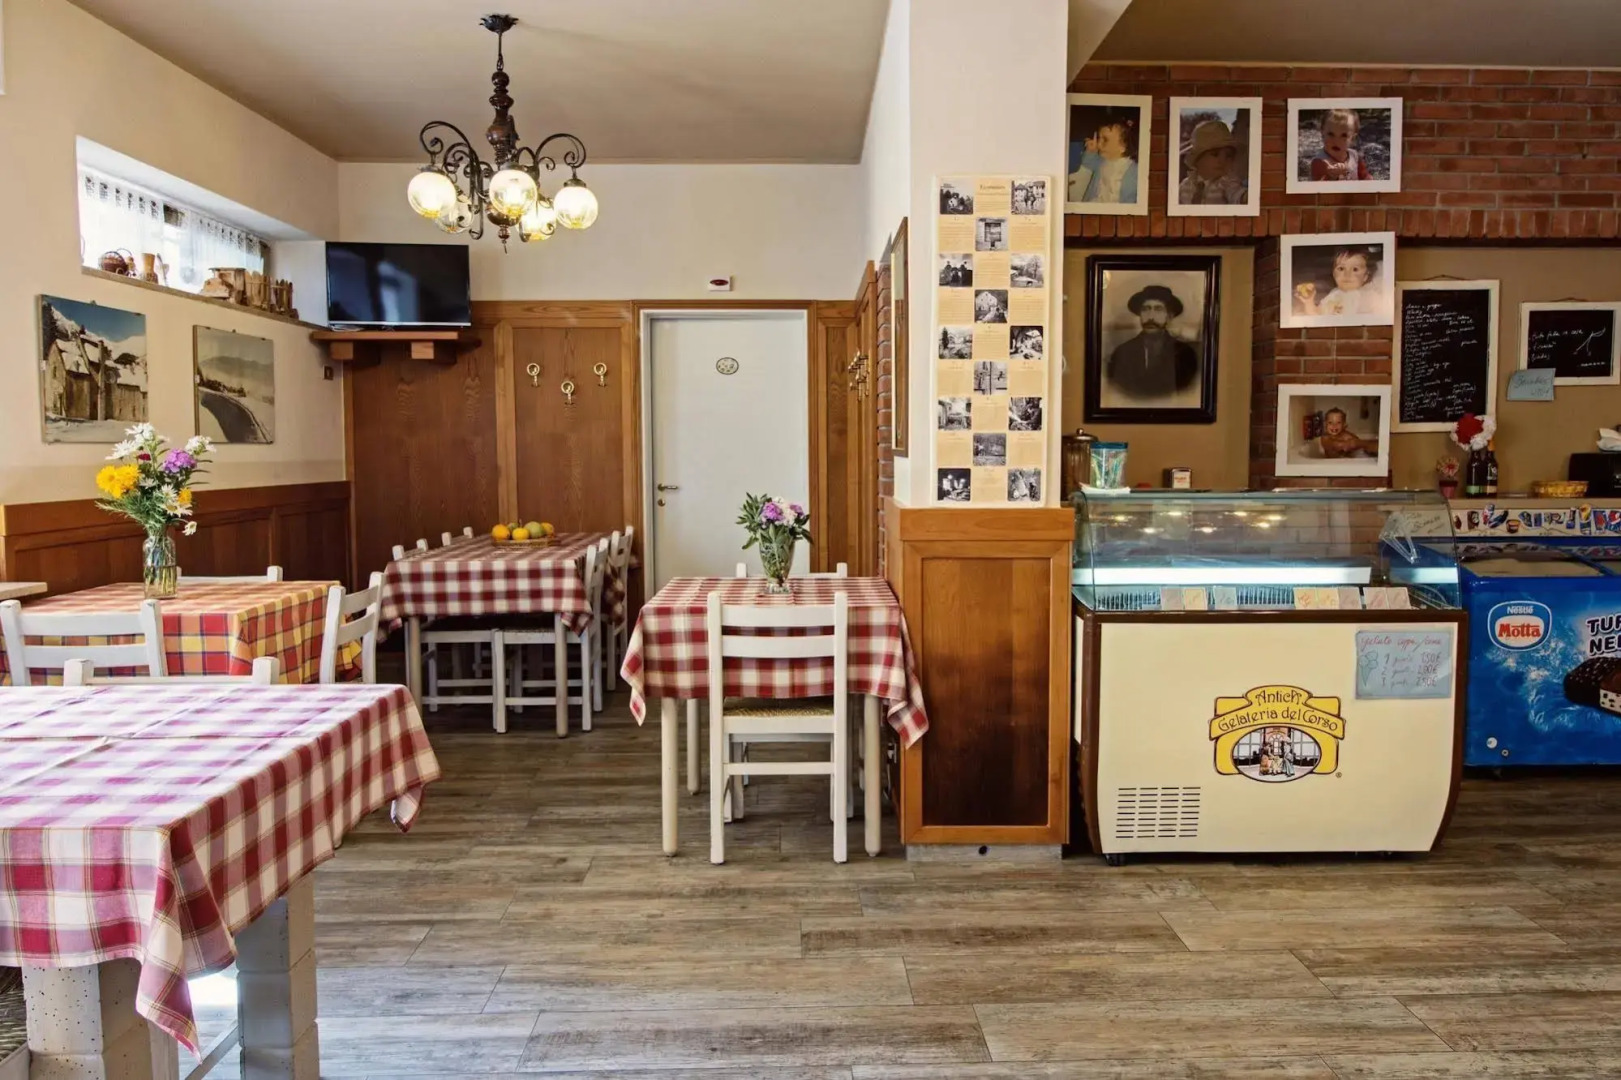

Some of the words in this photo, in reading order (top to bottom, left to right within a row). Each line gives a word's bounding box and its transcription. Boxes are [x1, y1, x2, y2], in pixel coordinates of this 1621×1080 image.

[1497, 622, 1541, 638] Motta
[1218, 707, 1278, 732] Gelateria
[1281, 706, 1302, 721] del
[1302, 709, 1338, 731] Corso
